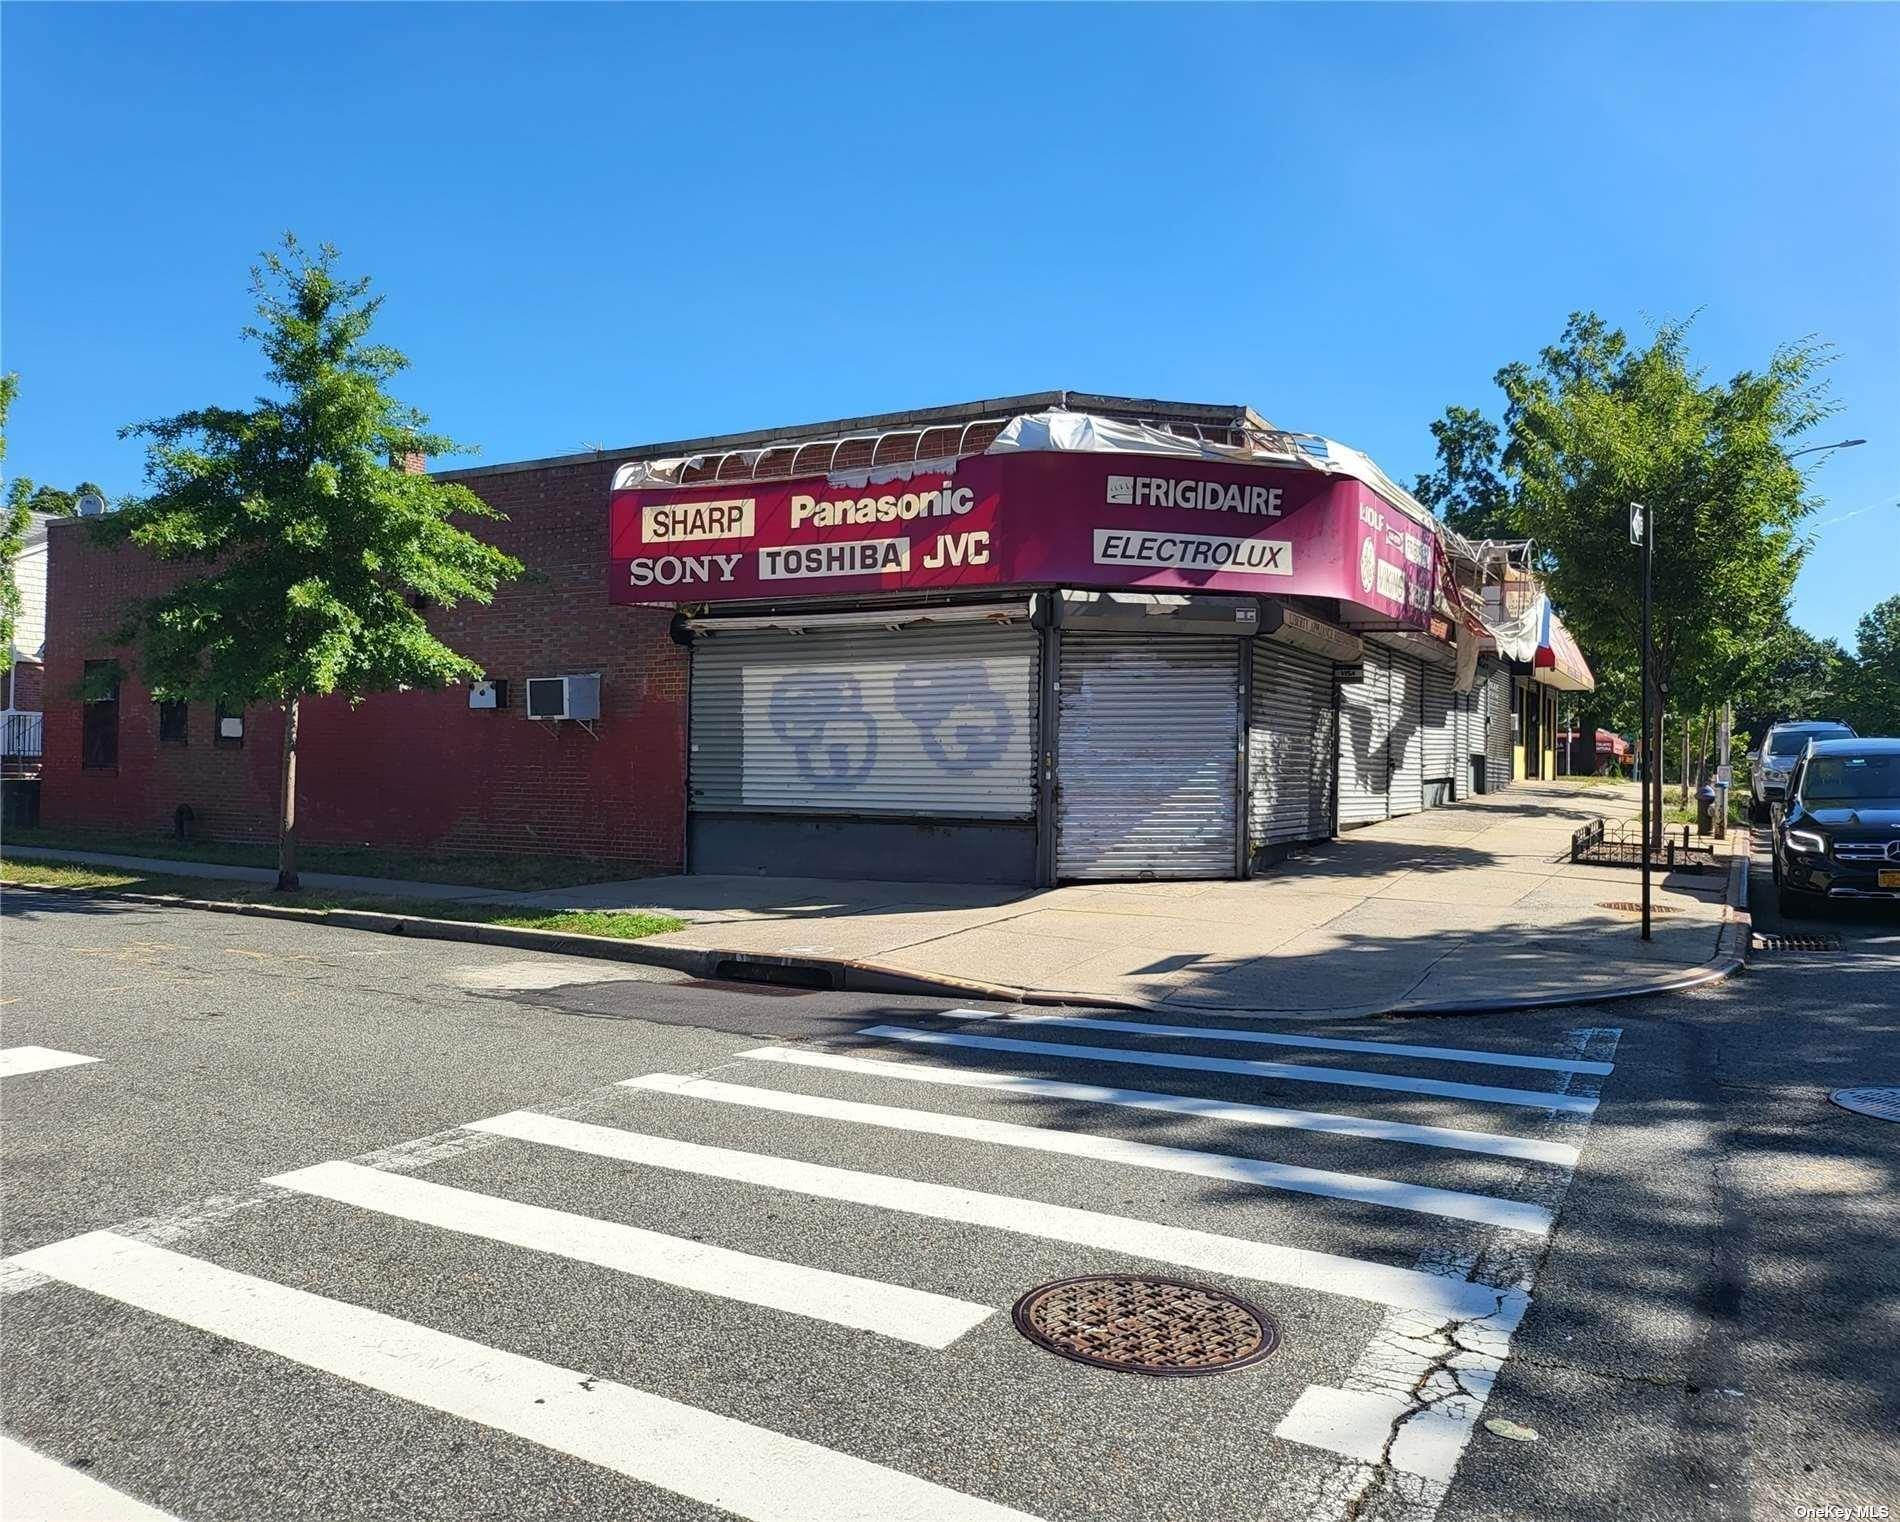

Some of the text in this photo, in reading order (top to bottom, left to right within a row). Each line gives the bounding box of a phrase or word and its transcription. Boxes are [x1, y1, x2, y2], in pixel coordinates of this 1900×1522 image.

[791, 480, 975, 528] Panasonic
[1135, 477, 1283, 516] FRIGIDAIRE
[653, 505, 744, 537] SHARP
[766, 542, 901, 575] TOSHIBA
[923, 531, 990, 568] JVC
[1101, 535, 1283, 568] ELECTROLUX
[630, 554, 743, 586] SONY
